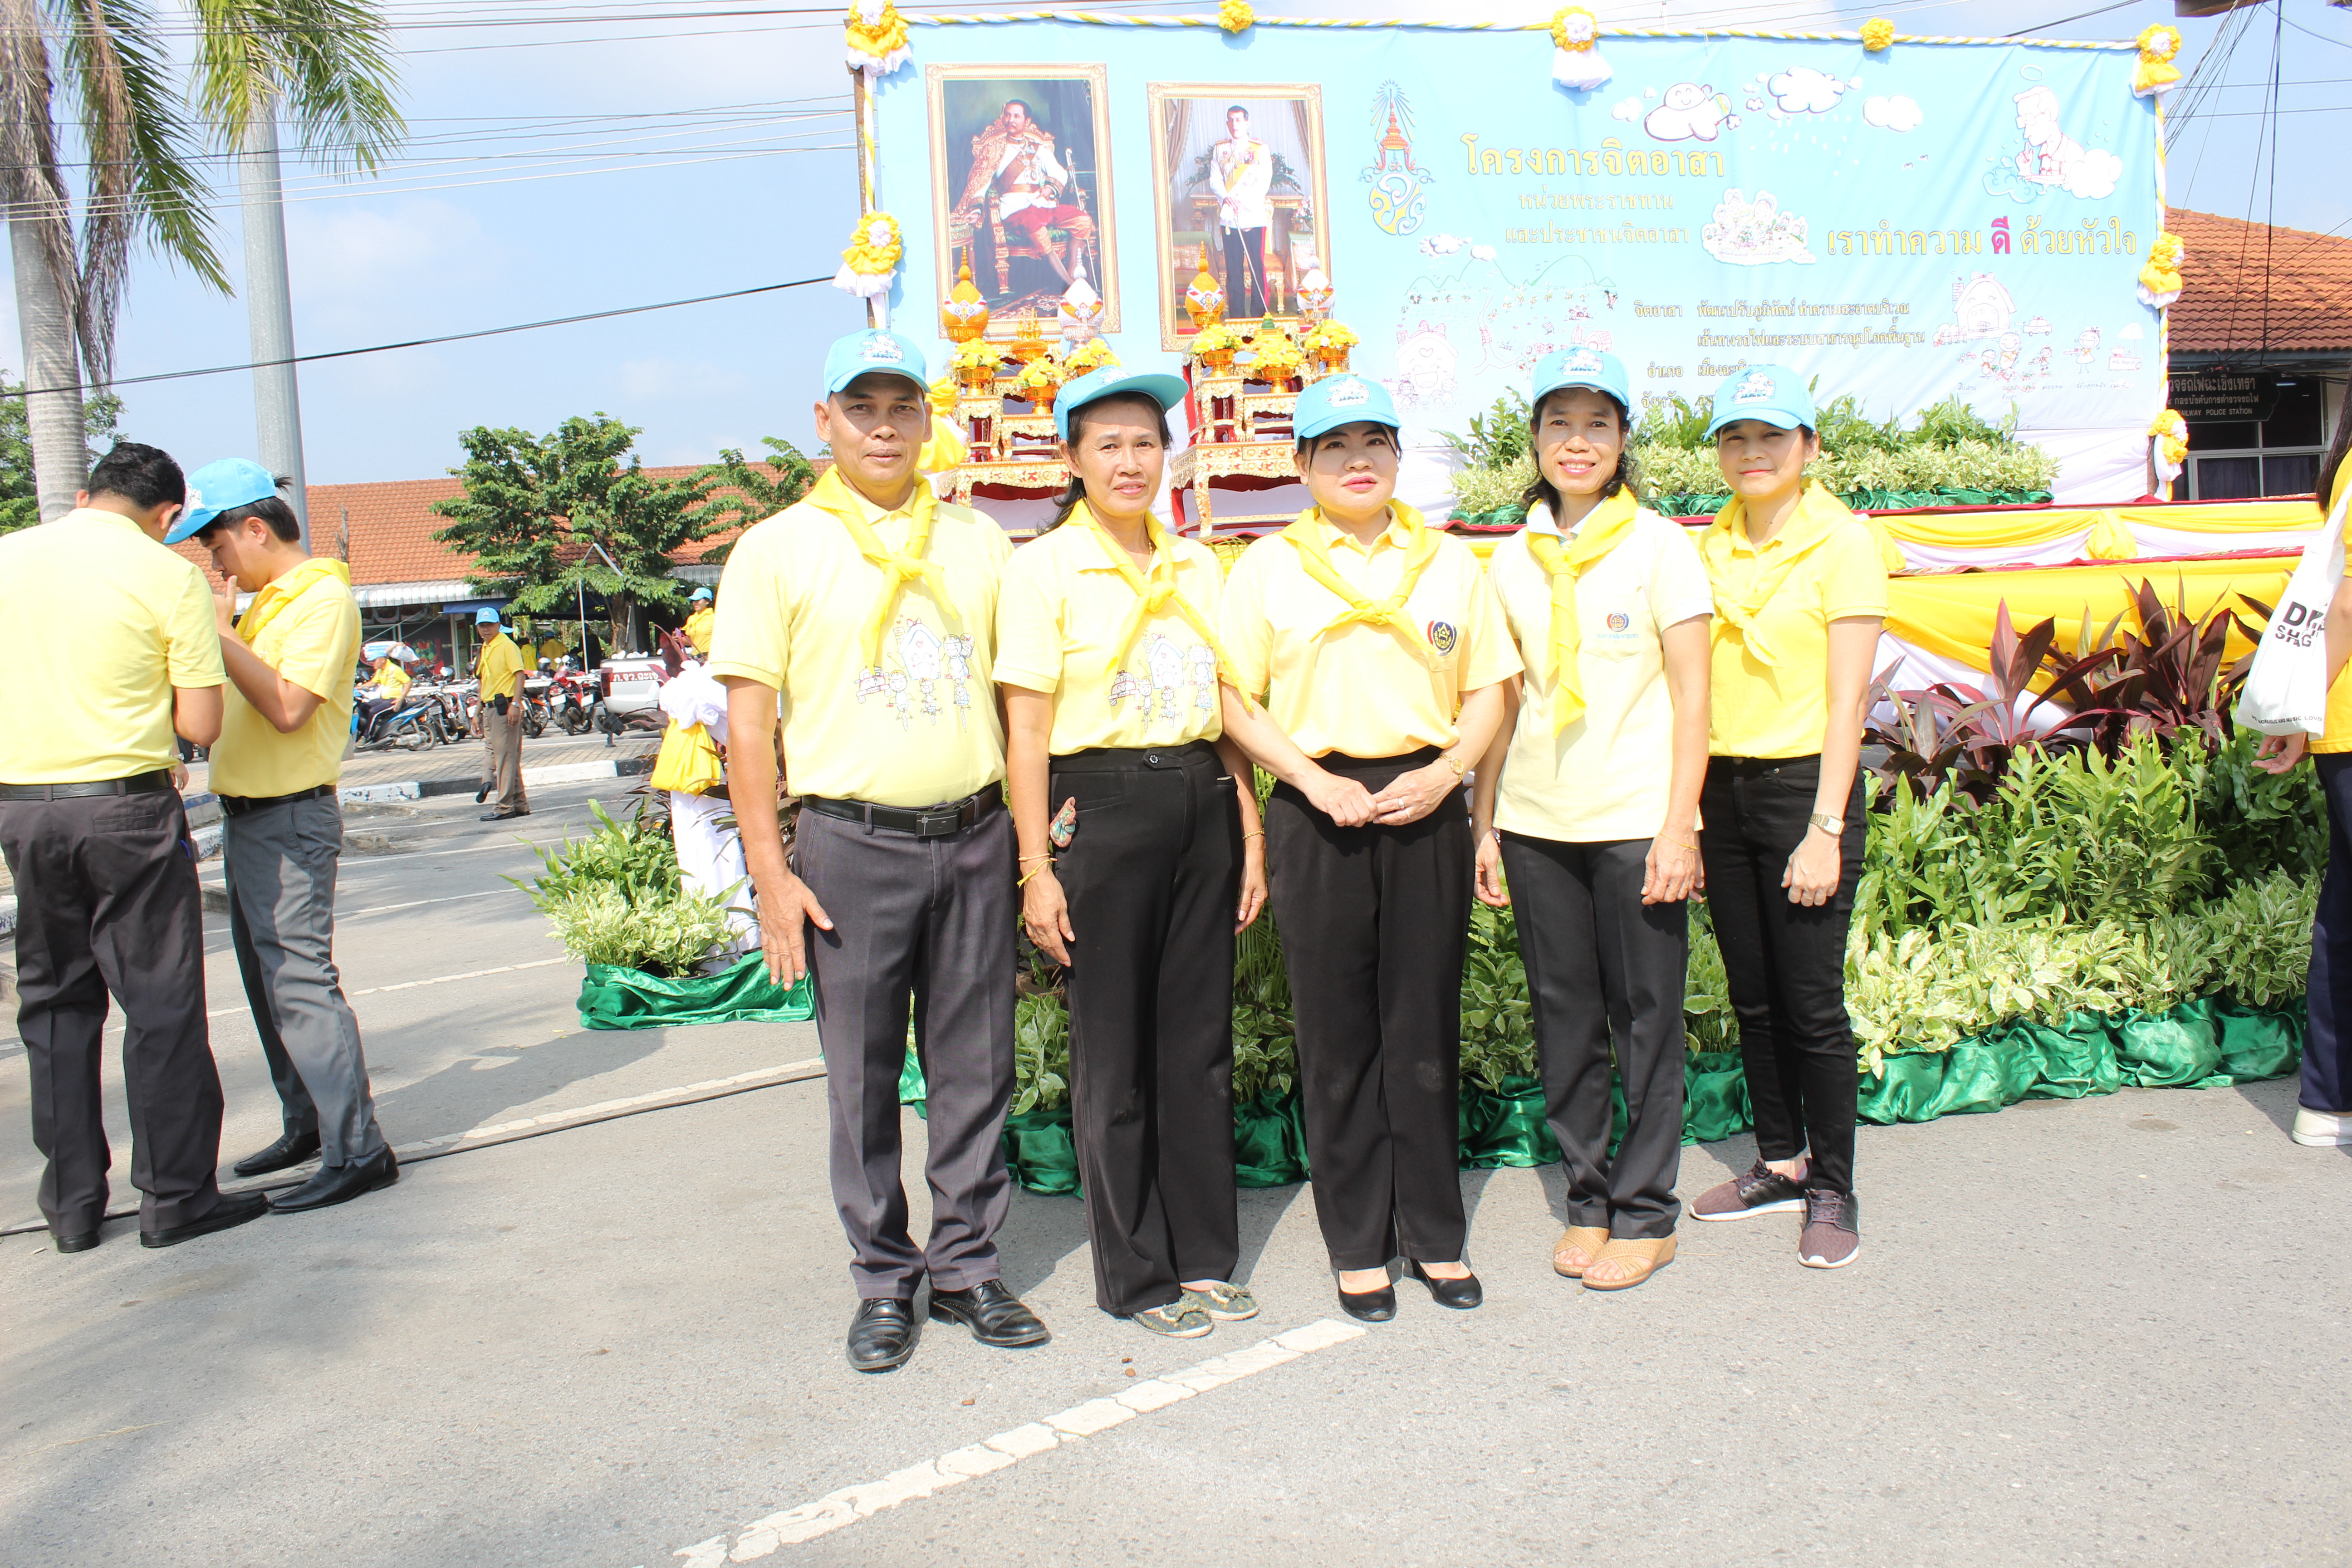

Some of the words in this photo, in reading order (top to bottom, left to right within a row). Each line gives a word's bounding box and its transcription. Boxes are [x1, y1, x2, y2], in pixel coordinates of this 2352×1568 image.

[1460, 132, 1725, 176] โครงการจิตอาสา
[1518, 186, 1674, 210] หน่วยพระราชทาน
[1506, 220, 1689, 244] และประชาชนจิตอาสา
[1827, 220, 1982, 255] เราทำความ
[1991, 216, 2011, 255] ดี
[2021, 215, 2136, 255] ด้วยหัวใจ
[1634, 300, 1682, 318] จิตอาสา
[1697, 298, 1795, 322] พัฒนาปรับภูมิทัศน์
[1798, 300, 1909, 317] ทำความสะอาดบริเวณ
[1647, 362, 1684, 378] อำเภอ
